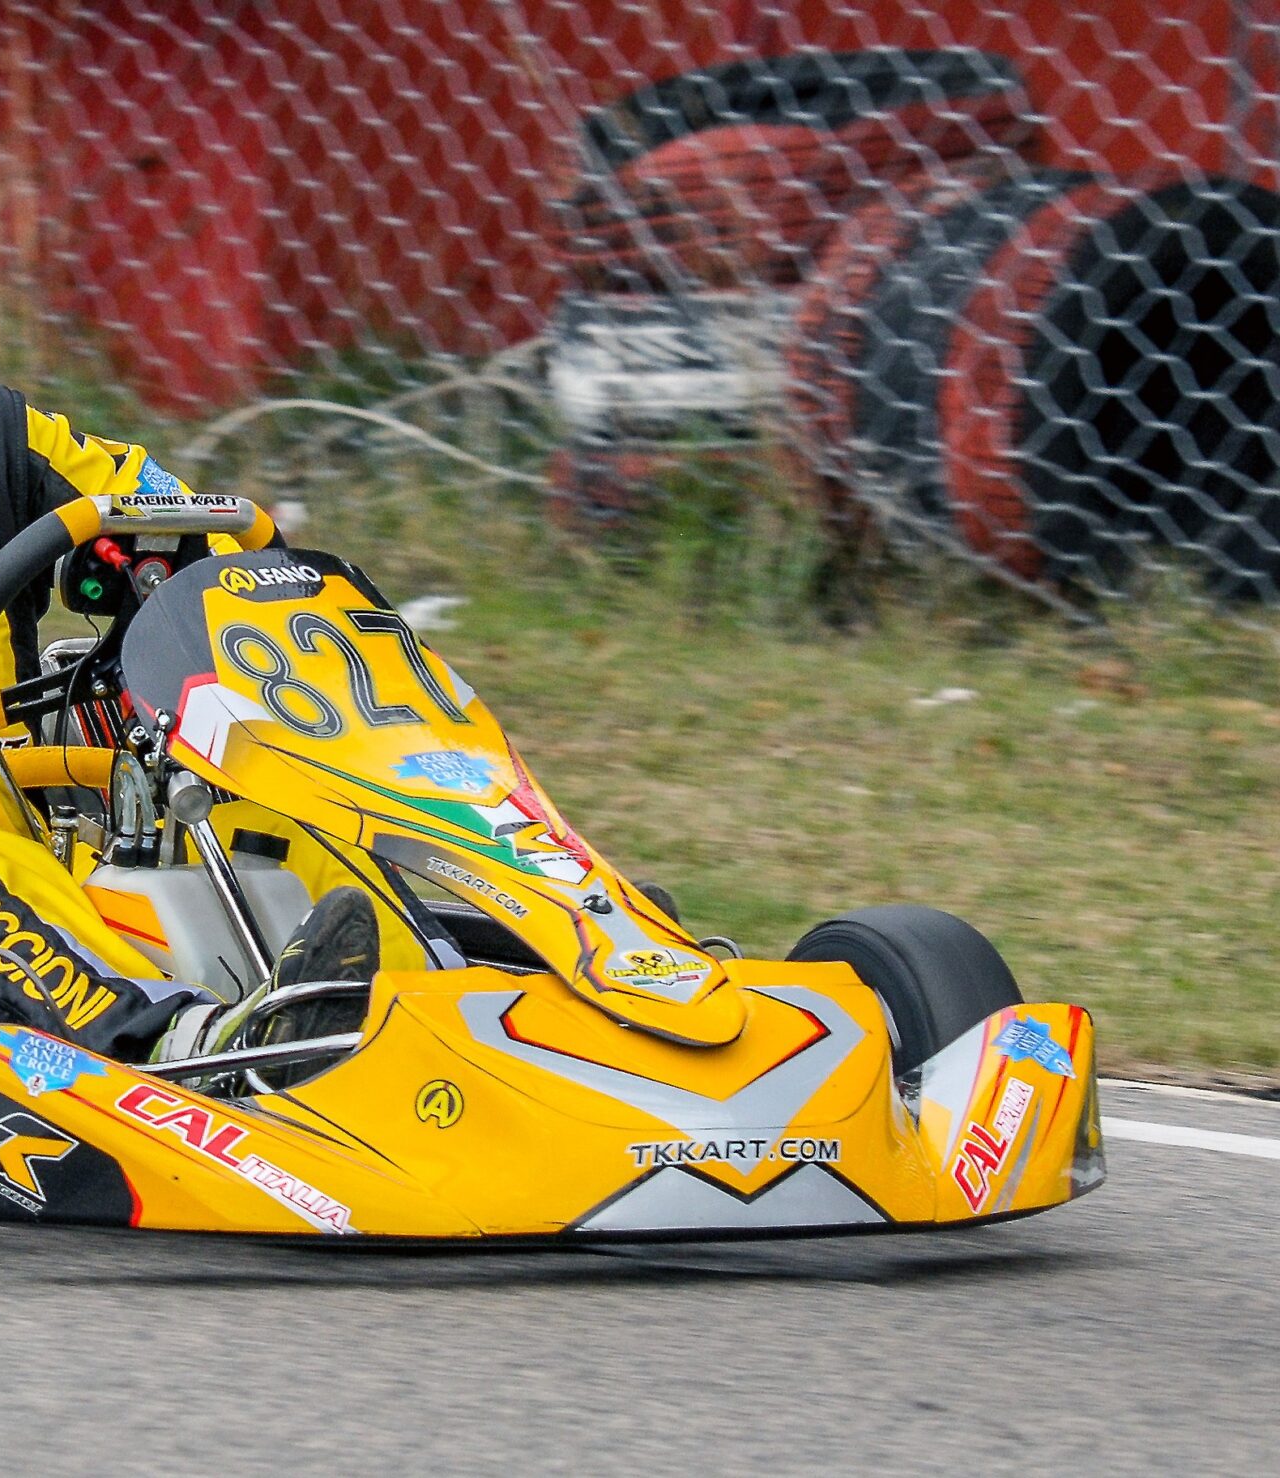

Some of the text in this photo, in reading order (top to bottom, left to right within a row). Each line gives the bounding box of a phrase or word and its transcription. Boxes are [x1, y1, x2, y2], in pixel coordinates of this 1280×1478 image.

[120, 494, 239, 507] RACING KART
[219, 565, 323, 594] ALFANO
[221, 609, 471, 738] 827
[426, 856, 529, 919] TKKART.COM
[21, 1044, 74, 1070] SANTA
[25, 1036, 77, 1059] ACQUA
[16, 1054, 70, 1081] CROCE
[115, 1085, 352, 1233] CAL ITALIA
[628, 1138, 840, 1166] TKKART.COM
[953, 1121, 1010, 1214] CAL
